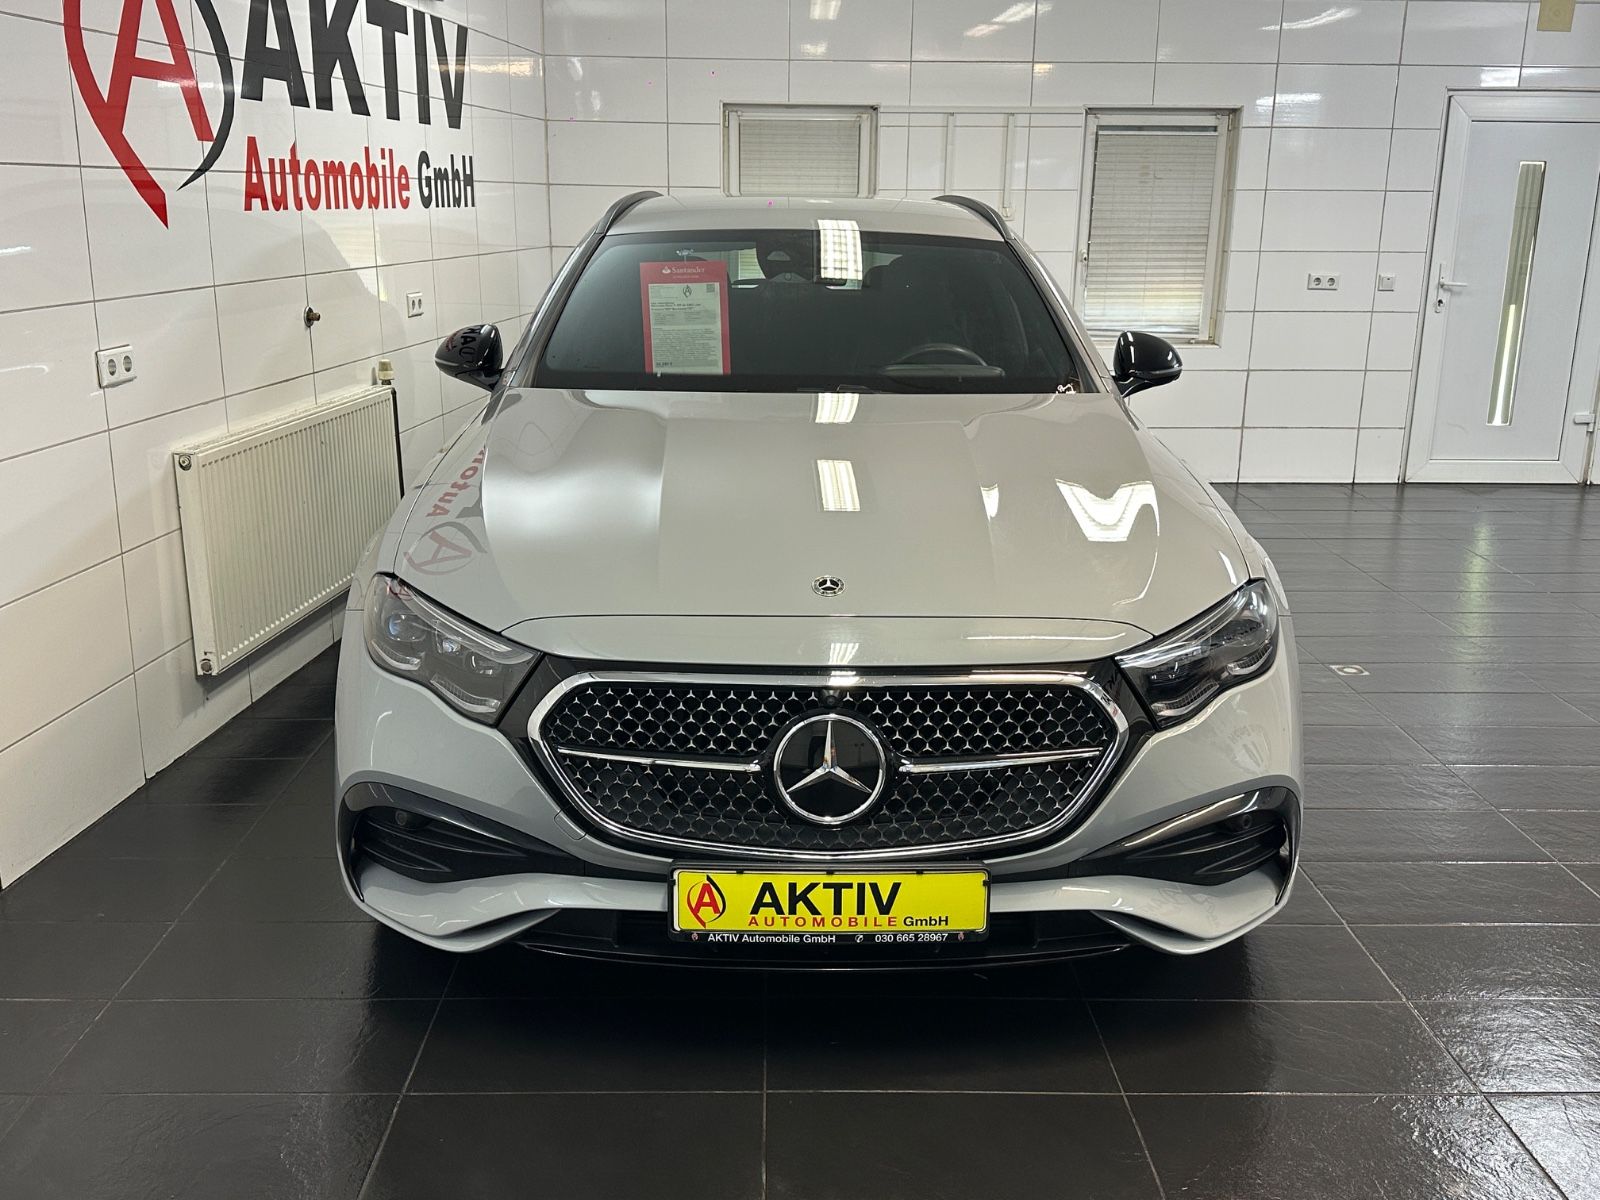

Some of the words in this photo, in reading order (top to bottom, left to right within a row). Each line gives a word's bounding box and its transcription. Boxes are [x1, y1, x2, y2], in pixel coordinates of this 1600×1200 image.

[240, 0, 468, 129] AKTIV
[244, 136, 411, 211] Automobile
[417, 150, 476, 209] GmbH
[749, 882, 902, 915] AKTIV
[748, 916, 897, 927] AUTOMOBILE
[903, 915, 949, 927] GmbH
[707, 933, 740, 942] AKTIV
[741, 933, 800, 943] Automobile
[802, 934, 836, 943] GmbH
[874, 934, 894, 943] 030
[896, 933, 915, 942] 665
[917, 933, 948, 942] 28967
